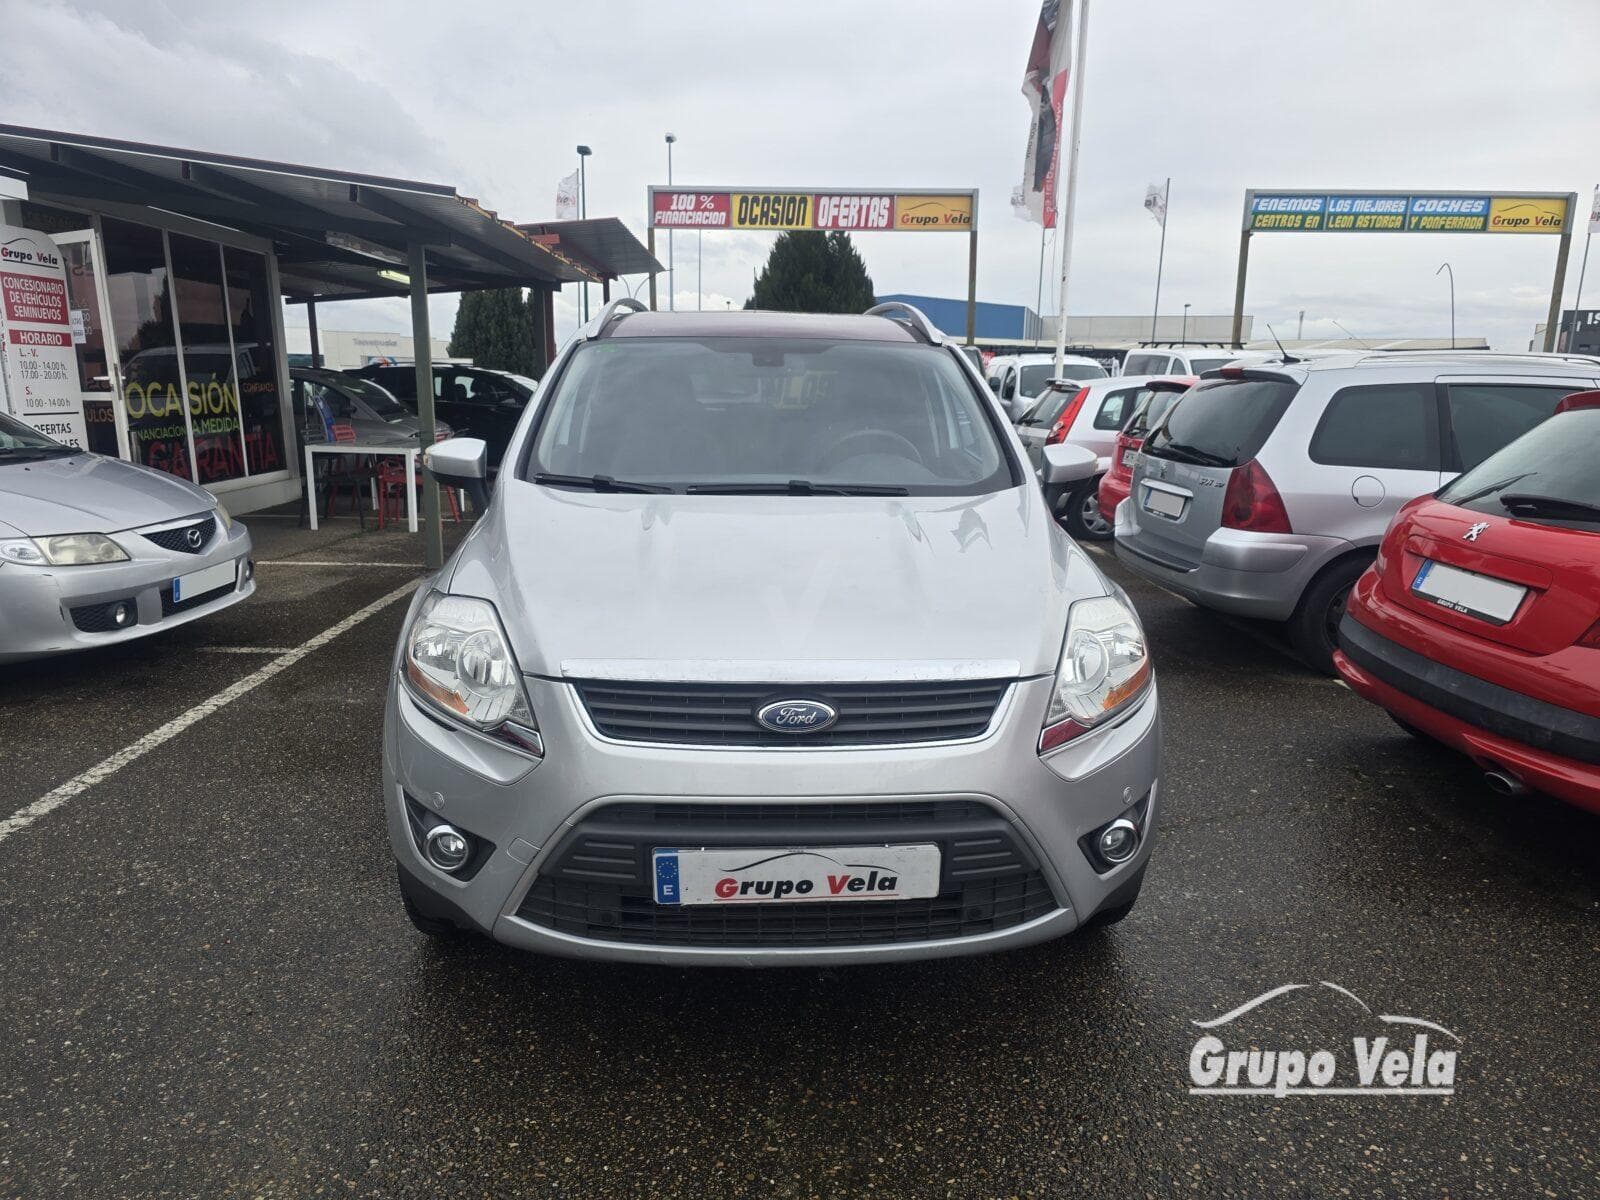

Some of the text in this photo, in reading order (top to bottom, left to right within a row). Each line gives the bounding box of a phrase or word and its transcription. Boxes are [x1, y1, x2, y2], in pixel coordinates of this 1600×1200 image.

[670, 194, 714, 210] 100 %
[1328, 199, 1350, 212] LOS
[1352, 200, 1407, 213] MEJORES
[1413, 200, 1485, 213] COCHES
[654, 211, 726, 225] FINANCIACION
[737, 195, 808, 226] OCASION
[817, 196, 891, 227] OFERTAS
[901, 213, 971, 227] Grupo Vela
[1255, 214, 1302, 228] CENTROS
[1304, 215, 1320, 228] EN
[1355, 215, 1403, 229] ASTORGA
[1410, 216, 1417, 229] Y
[1420, 216, 1486, 230] PONFERRADA
[1492, 215, 1561, 228] Grupo Vela
[1, 247, 58, 265] Grupo Vela
[3, 276, 64, 295] CONCESIONARIO
[10, 291, 62, 307] DE VEHÍCULOS
[14, 305, 62, 320] SEMINUEVOS
[20, 331, 62, 345] HORARIO
[124, 373, 240, 418] OCASIÓN
[201, 417, 240, 434] MEDIDA
[776, 708, 817, 726] Ford
[663, 884, 674, 896] E
[715, 871, 898, 899] Grupo Vela
